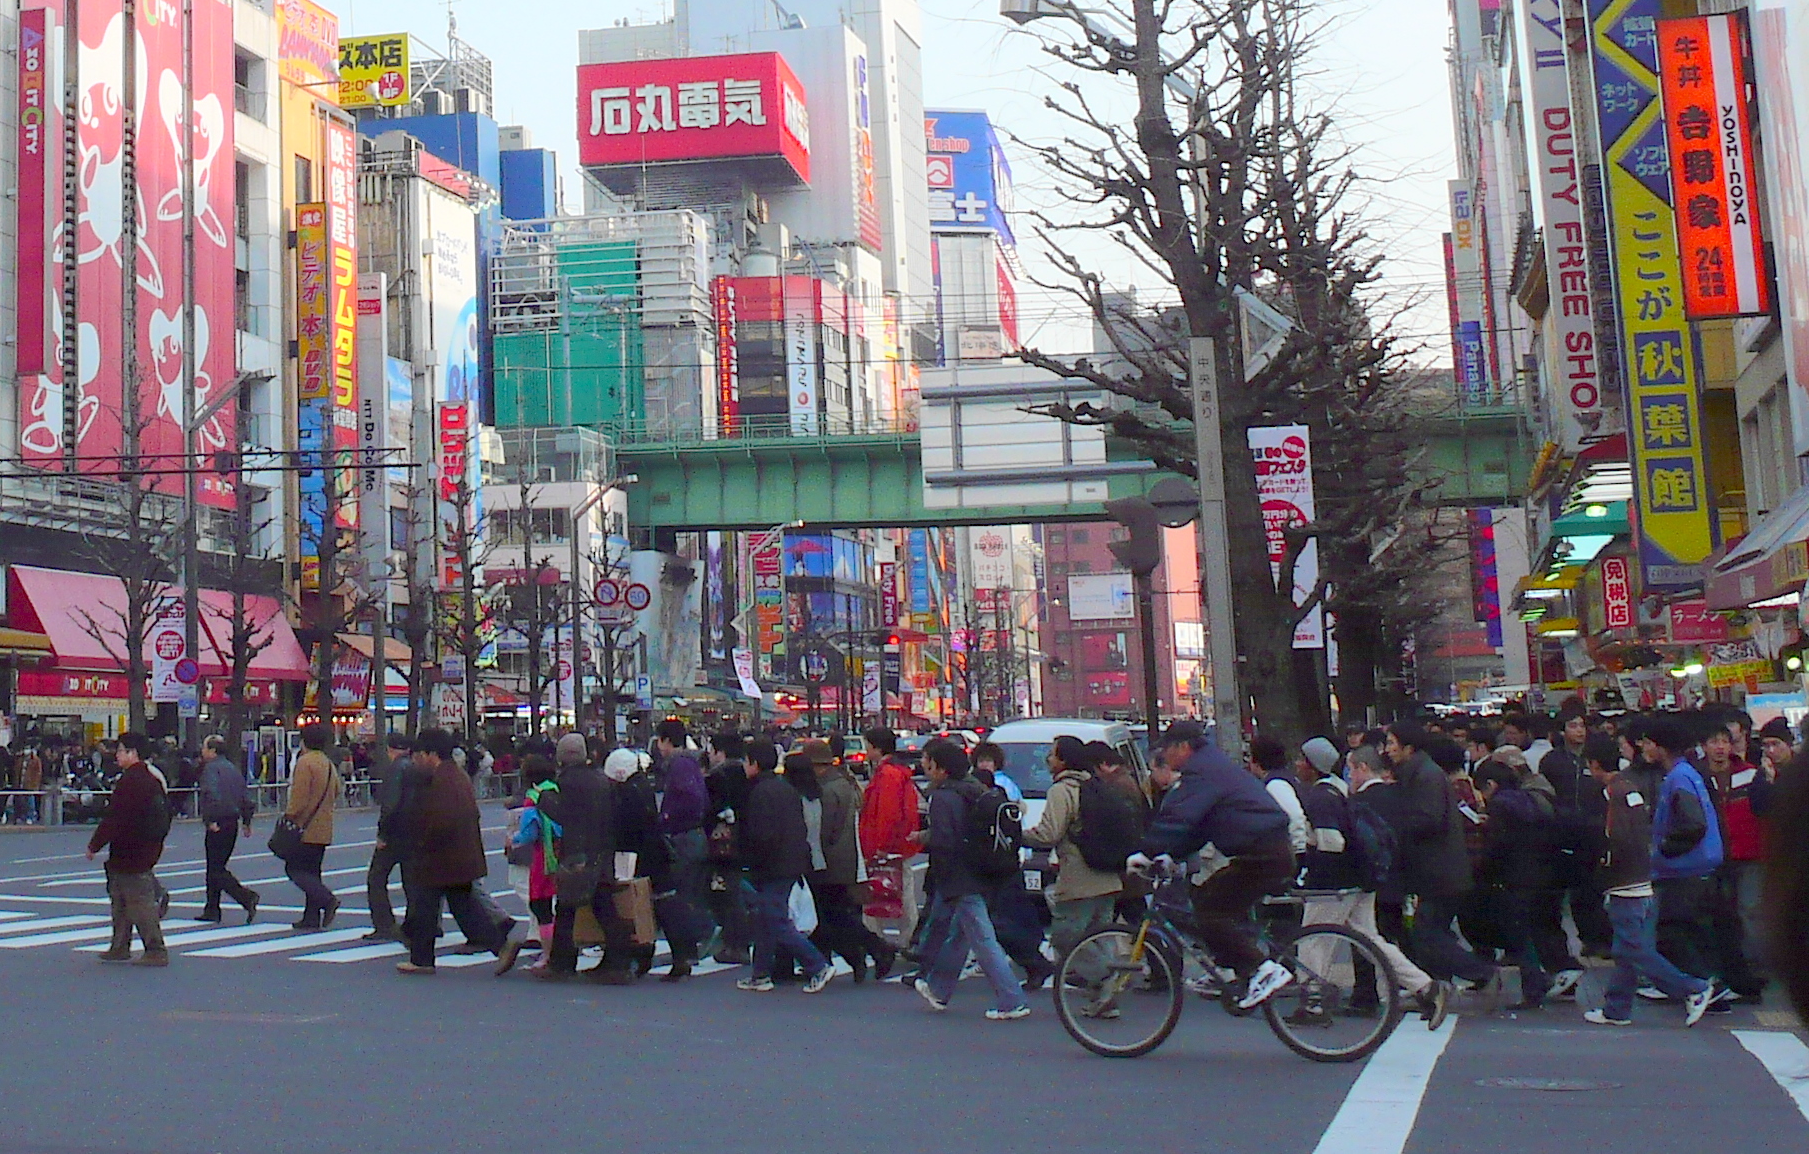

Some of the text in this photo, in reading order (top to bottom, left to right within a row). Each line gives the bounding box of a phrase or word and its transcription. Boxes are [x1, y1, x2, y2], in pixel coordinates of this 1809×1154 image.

[1675, 36, 1700, 88] 牛丼
[589, 78, 767, 136] 石丸電気
[1541, 106, 1580, 205] DUTY
[1677, 105, 1721, 229] 吉野家
[1722, 105, 1747, 225] YOSHINOYA
[1555, 222, 1588, 317] FREE
[1631, 210, 1671, 322] ここが
[1695, 246, 1723, 270] 24
[1565, 331, 1599, 411] SHO
[1640, 338, 1696, 511] 秋葉館
[883, 565, 894, 624] Duty Free
[1604, 559, 1629, 626] 免税店
[1673, 609, 1720, 624] ラーメン
[638, 678, 648, 689] P
